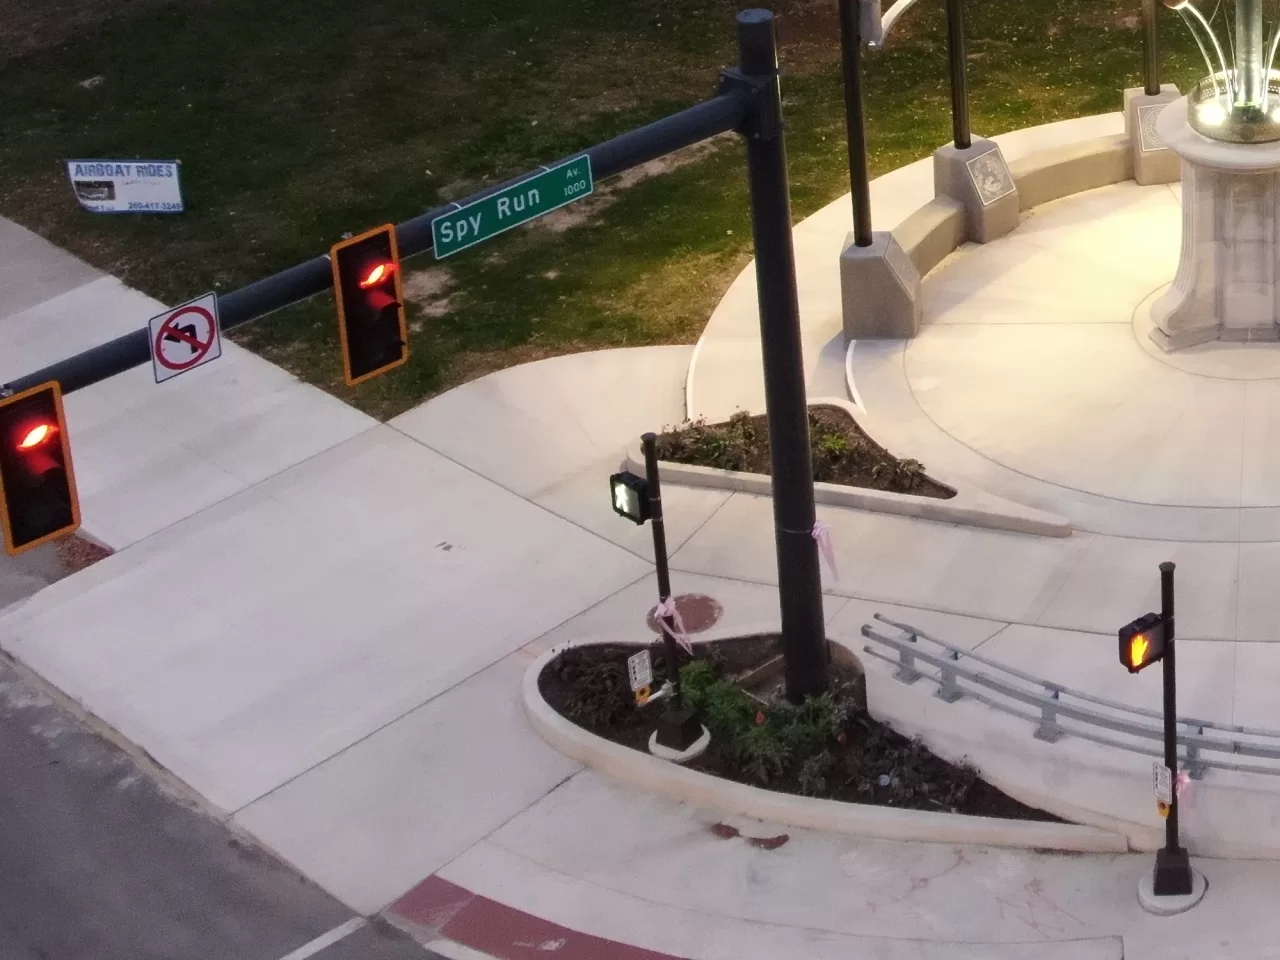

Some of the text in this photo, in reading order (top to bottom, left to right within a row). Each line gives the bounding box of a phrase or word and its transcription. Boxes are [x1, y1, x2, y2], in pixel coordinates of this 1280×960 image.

[74, 164, 173, 177] AIRBOAT RIDES
[566, 168, 581, 180] Av.
[563, 179, 586, 197] 1000
[440, 188, 540, 243] Spy Run
